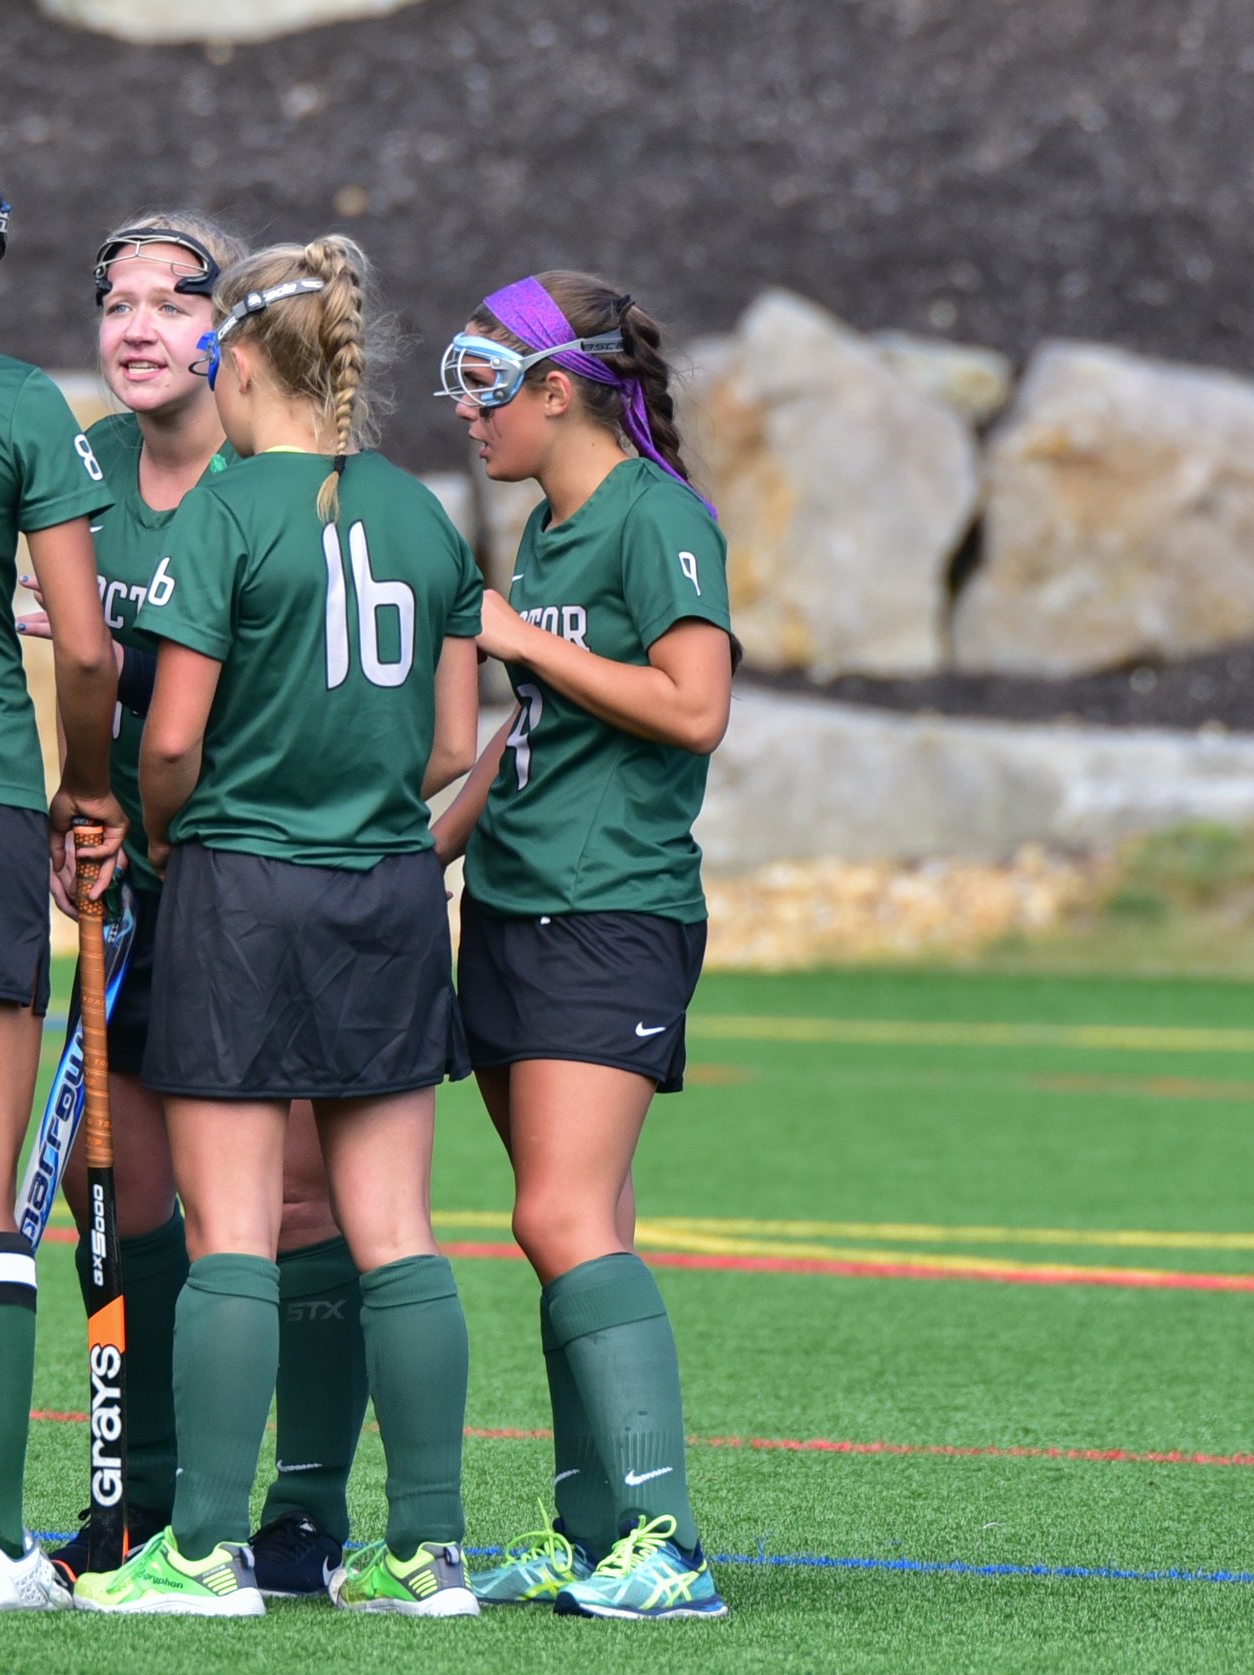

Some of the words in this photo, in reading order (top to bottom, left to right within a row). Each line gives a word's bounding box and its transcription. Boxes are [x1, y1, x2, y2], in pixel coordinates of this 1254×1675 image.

[74, 434, 103, 481] 8
[678, 551, 702, 597] 9
[322, 519, 417, 692] 16
[91, 1183, 107, 1287] GX5000
[287, 1299, 348, 1321] STX
[143, 1571, 184, 1589] gryphon
